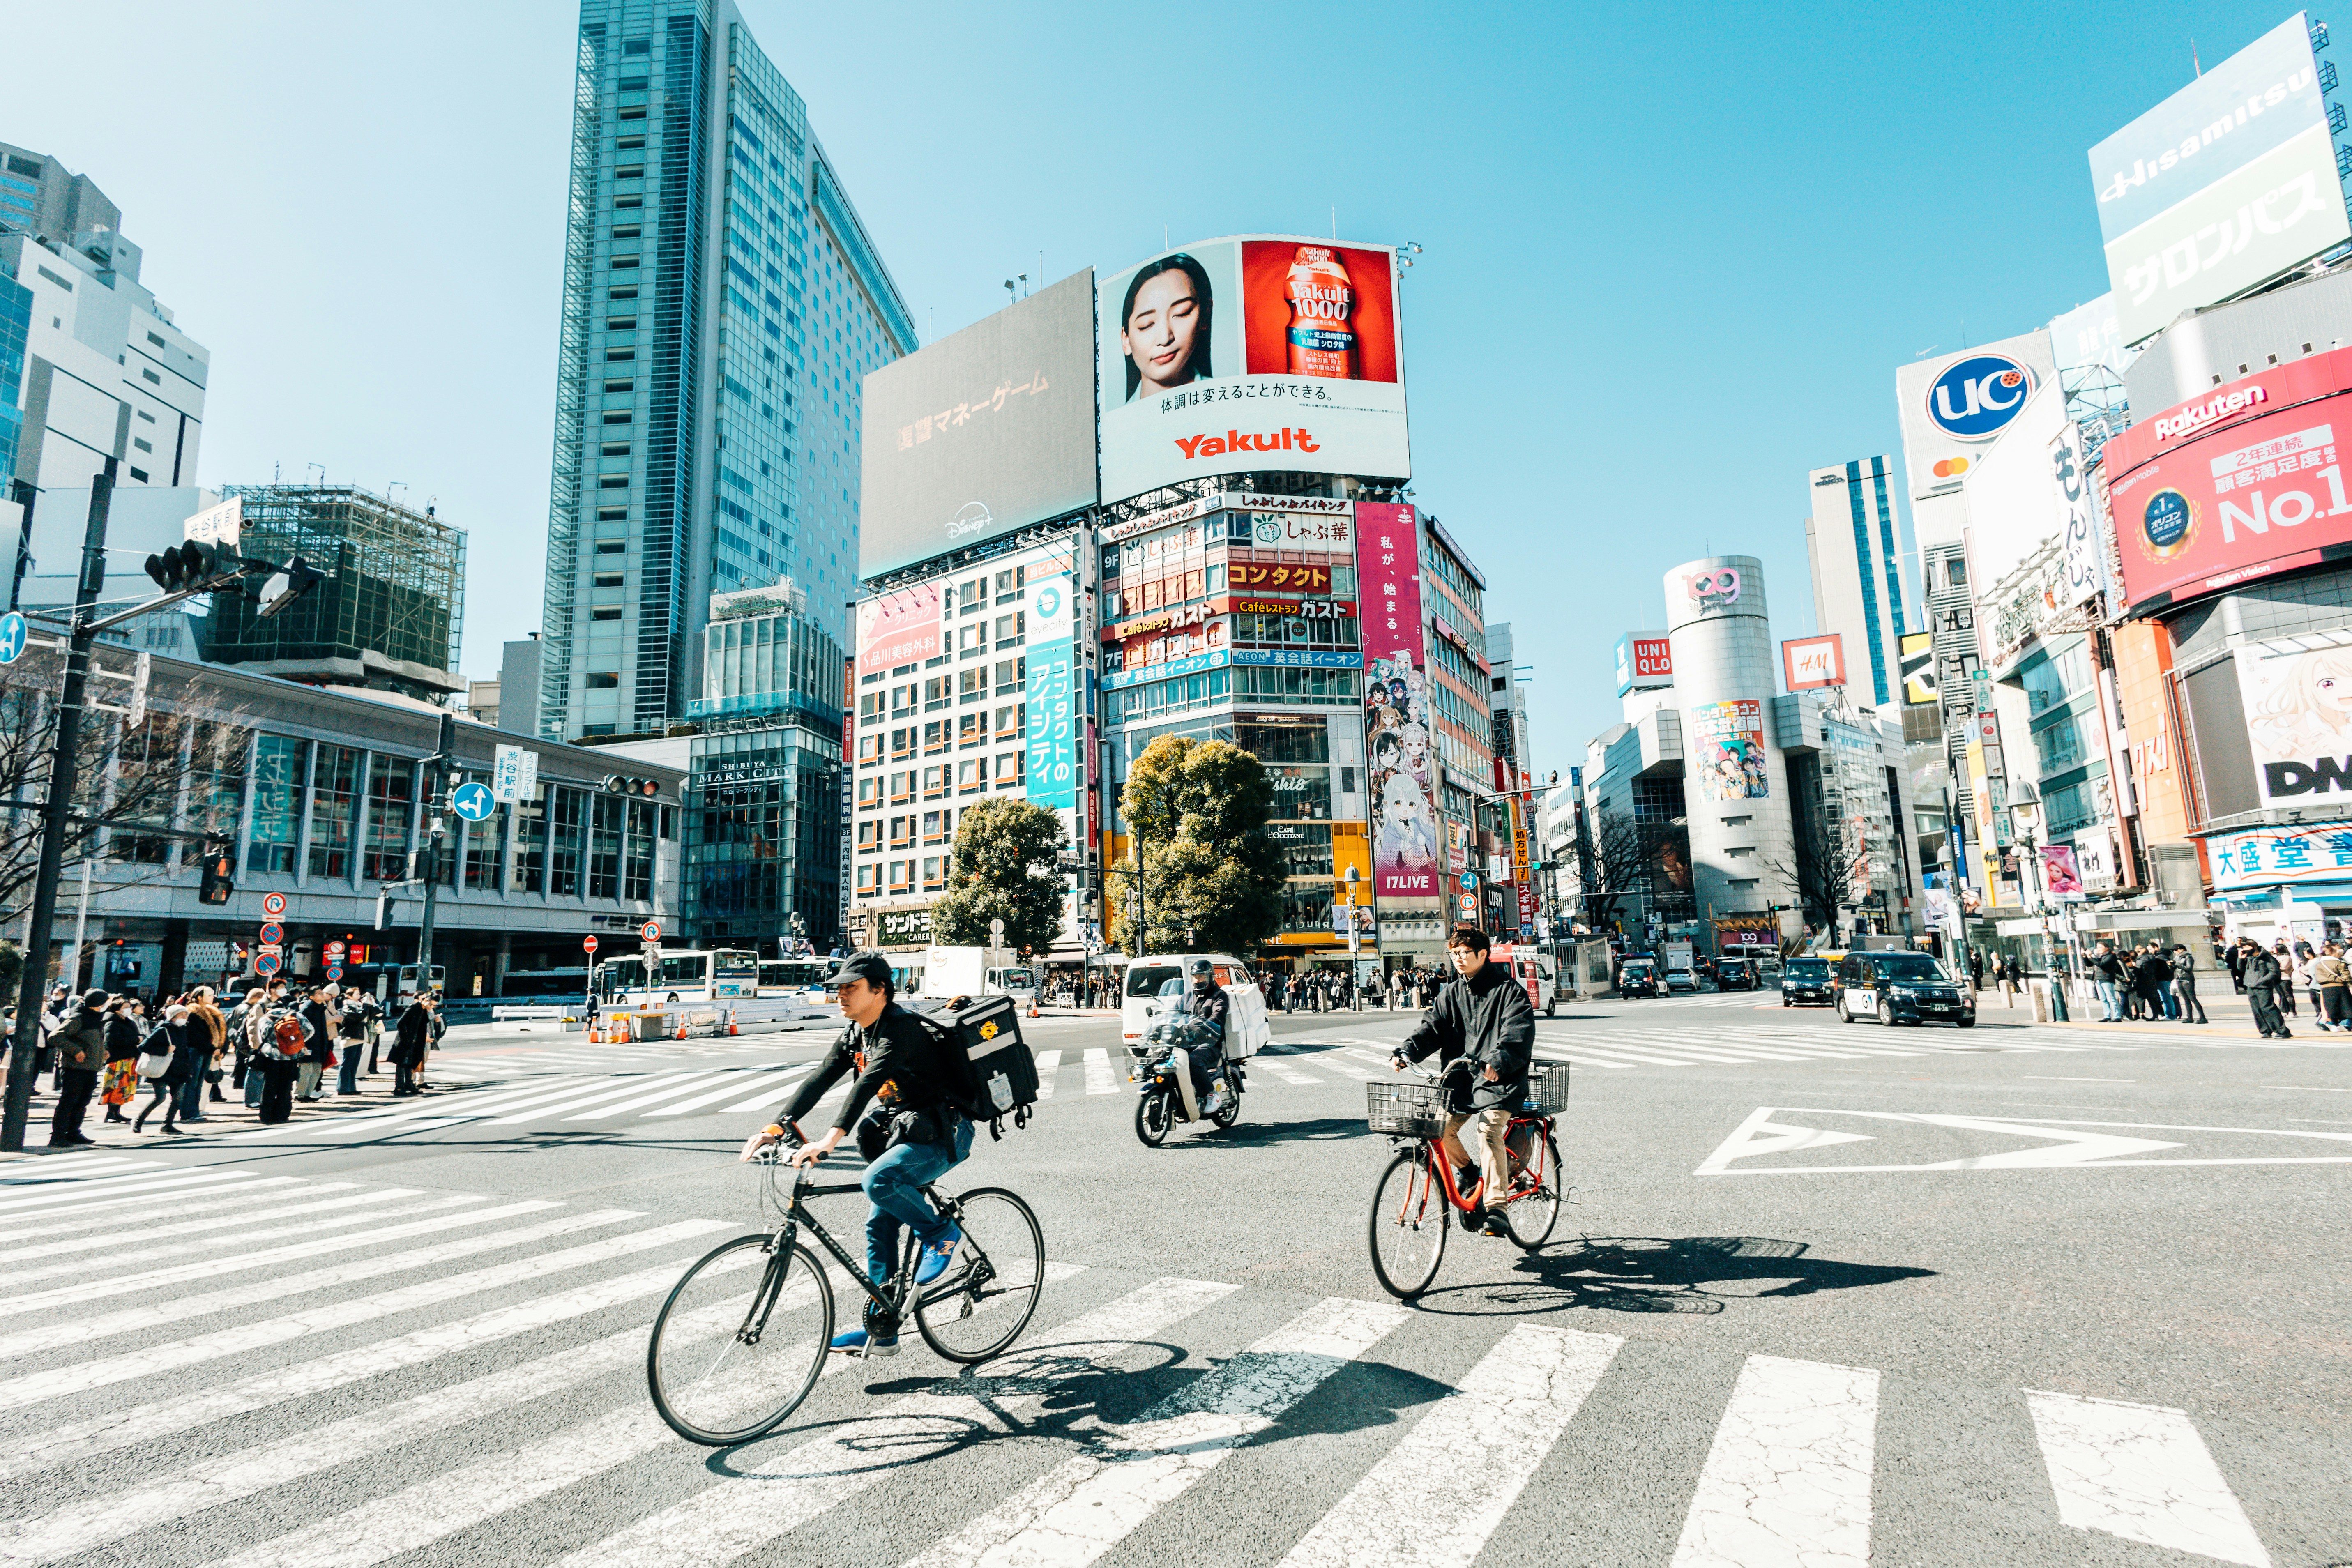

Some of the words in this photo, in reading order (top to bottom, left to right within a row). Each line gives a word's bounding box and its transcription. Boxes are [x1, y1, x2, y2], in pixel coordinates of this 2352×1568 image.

[2099, 65, 2312, 203] Hisamitsu
[2123, 169, 2327, 307] サロンパス
[1290, 282, 1350, 302] Yakult
[1291, 298, 1348, 320] 1000
[2077, 317, 2121, 356] 龍角
[1936, 369, 2023, 421] UC
[2154, 385, 2266, 440] Rakuten
[1174, 427, 1320, 460] Yakult
[2235, 435, 2303, 467] 2年連続
[2112, 477, 2137, 497] Rakuten
[2136, 464, 2160, 481] Mobile
[2214, 451, 2323, 494] 顧客満足度
[1242, 495, 1347, 512] しゃぶしゃぶバイキング
[2053, 436, 2095, 589] もんじゃ
[2218, 464, 2352, 543] No.1
[945, 509, 993, 540] Disney+
[1287, 520, 1348, 542] しゃぶ葉
[1150, 527, 1198, 556] しゃぶ葉
[1104, 553, 1119, 568] 9F
[1230, 566, 1327, 587] コンタクト
[1380, 535, 1400, 641] 私が、始まる。
[1682, 567, 1741, 605] 109
[2205, 572, 2241, 589] Rakuten
[2241, 564, 2271, 580] Vision
[1171, 603, 1212, 629] ガスト
[1240, 601, 1297, 614] Caféレストラン
[1301, 601, 1347, 619] ガスト
[1030, 618, 1068, 636] eyecity
[870, 637, 935, 666] 品川美容外科
[1105, 651, 1122, 668] 7F
[1237, 651, 1267, 663] AEON
[1274, 652, 1361, 665] 英会話イーオン
[1638, 643, 1667, 657] UNI
[1799, 653, 1827, 672] H&M
[1104, 674, 1127, 687] AEON
[1134, 658, 1206, 682] 英会話イーオン
[1212, 655, 1223, 664] 6F
[1640, 658, 1670, 674] QLO
[1030, 664, 1052, 784] アイシティ
[1054, 659, 1069, 781] コンタクトの
[1694, 715, 1761, 738] 日本武道館
[504, 751, 518, 798] 渋谷駅前
[523, 753, 534, 798] スクランブル式
[698, 771, 746, 783] MARK
[752, 767, 790, 778] CITY
[721, 760, 766, 770] SHIBUYA
[843, 774, 852, 815] 加藤眼科
[1449, 825, 1456, 846] 薬
[842, 847, 850, 861] 内科
[1386, 876, 1429, 889] 17LIVE
[1488, 890, 1503, 908] LUSH
[1519, 885, 1532, 923] スギ薬局
[885, 912, 932, 934] サンドラ
[1740, 933, 1758, 944] 109
